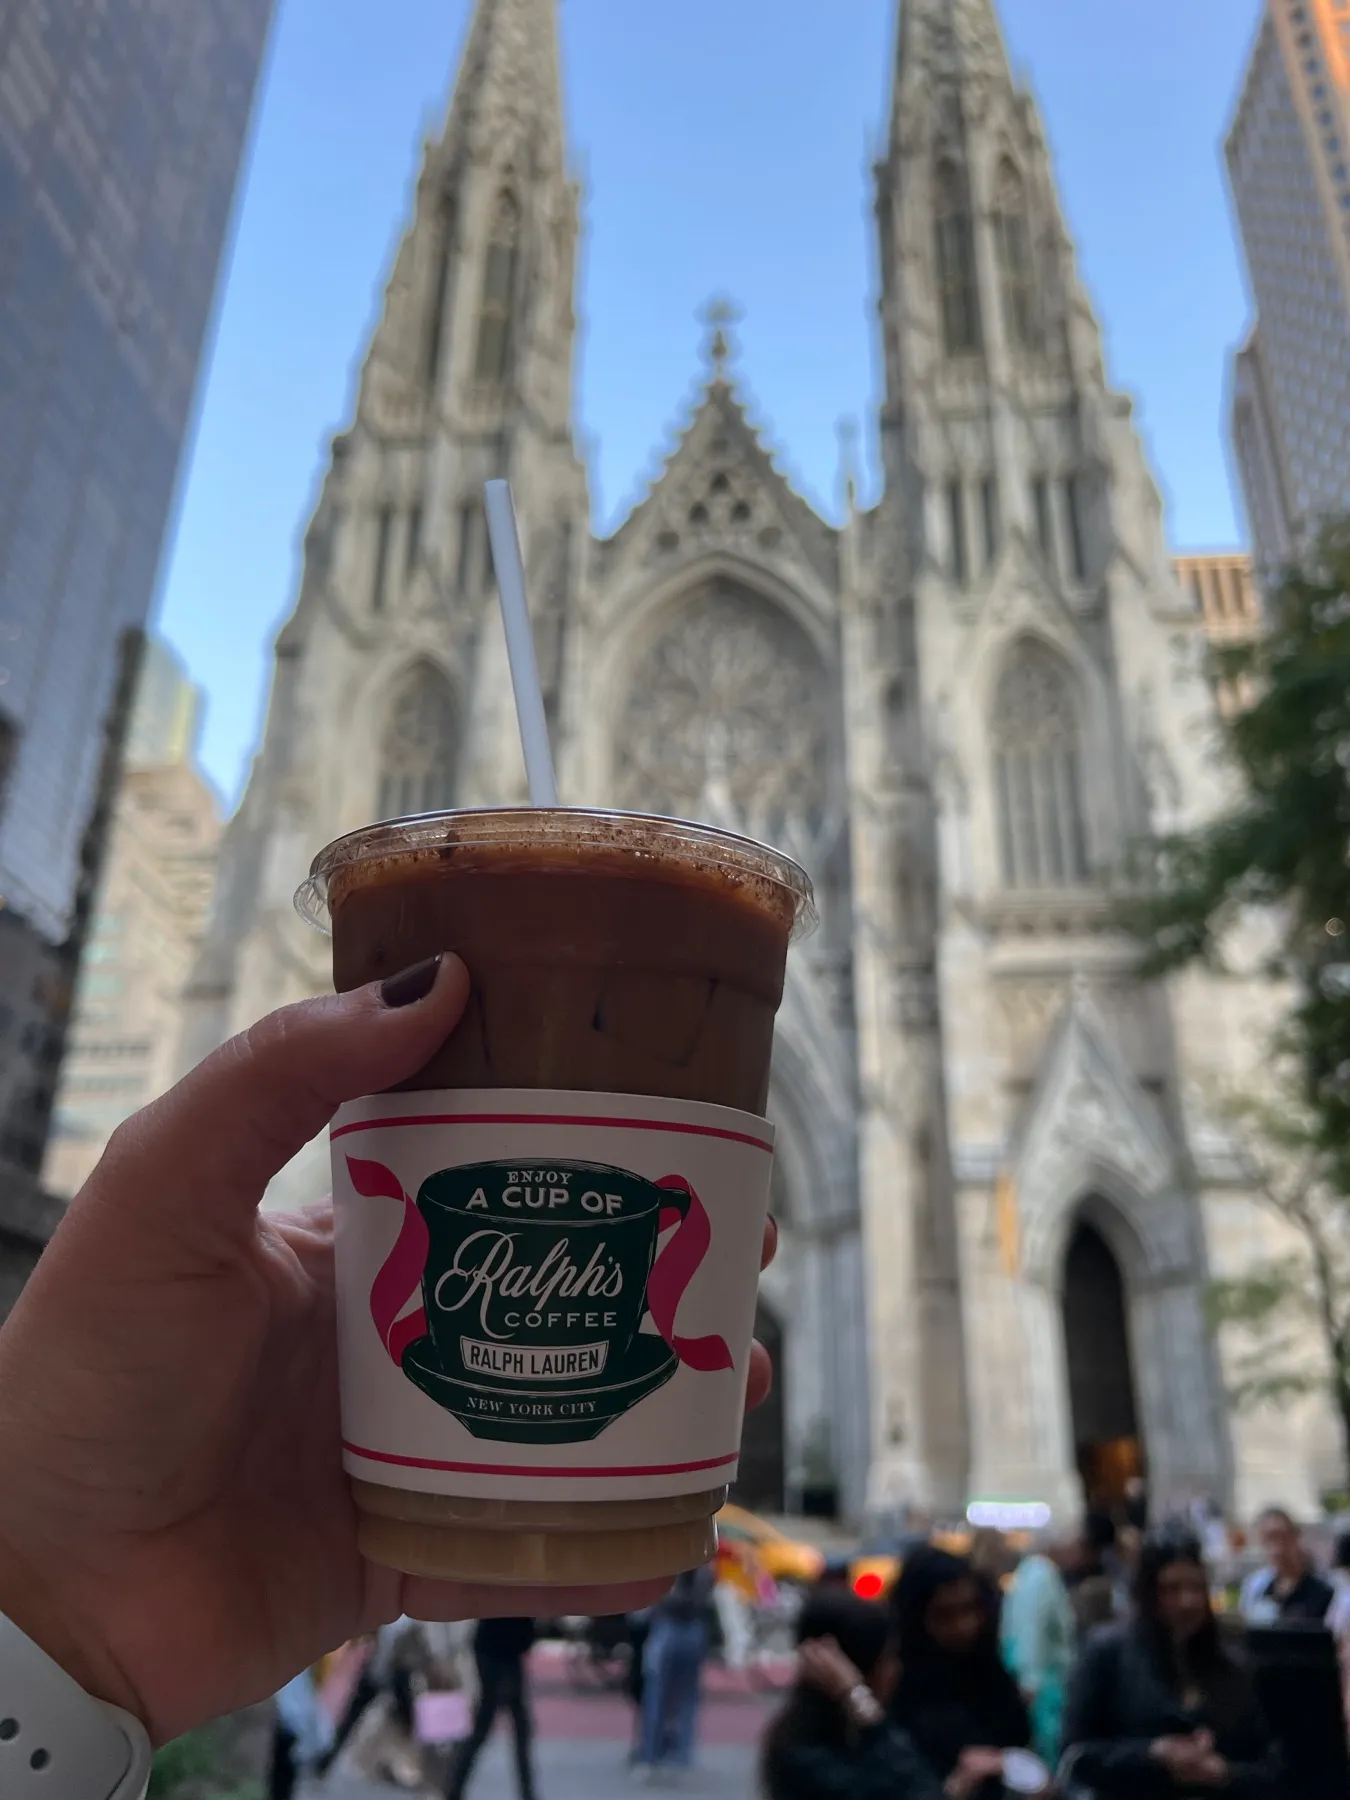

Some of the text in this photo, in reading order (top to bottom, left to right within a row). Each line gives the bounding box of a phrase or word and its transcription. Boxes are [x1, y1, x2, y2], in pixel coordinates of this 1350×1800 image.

[507, 1170, 572, 1185] ENJOY
[466, 1187, 623, 1216] A CUP OF
[435, 1229, 623, 1339] Ralph's
[504, 1312, 617, 1328] COFFEE
[470, 1345, 599, 1375] RALPH LAUREN
[467, 1396, 597, 1416] NEW YORK CITY
